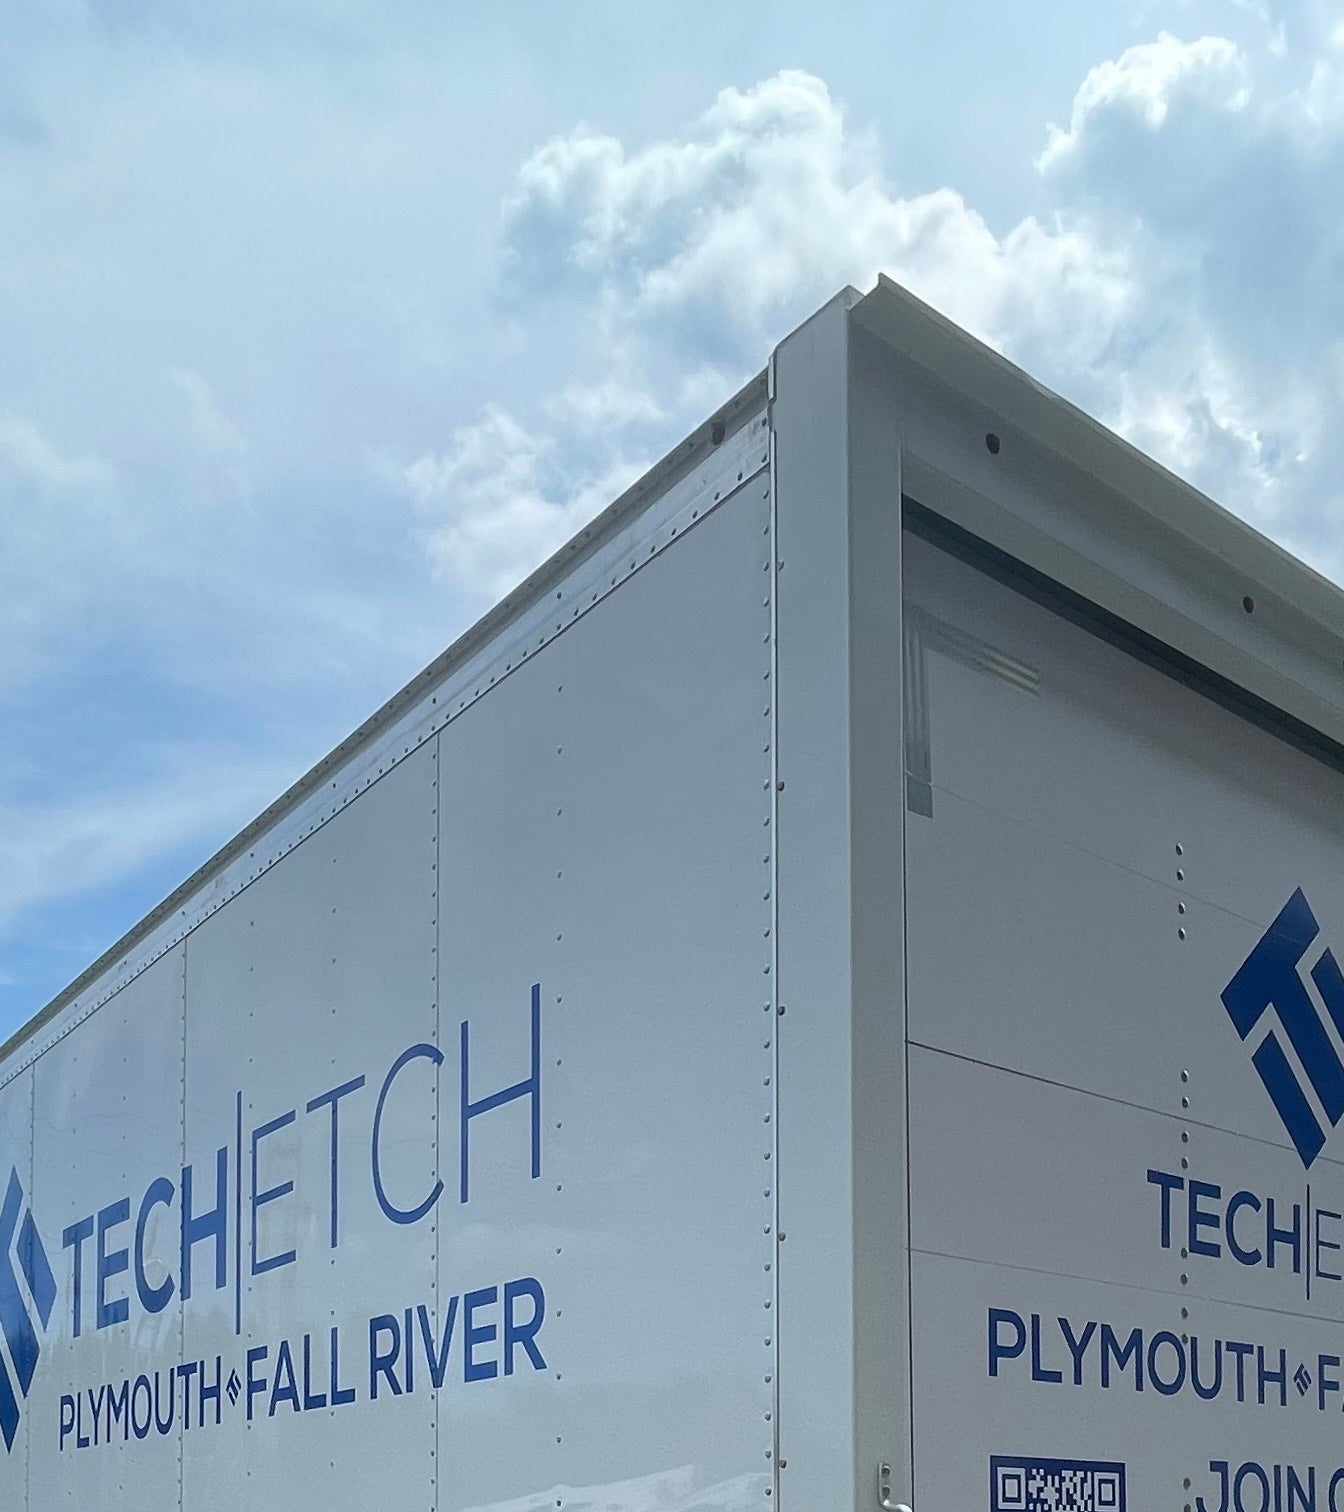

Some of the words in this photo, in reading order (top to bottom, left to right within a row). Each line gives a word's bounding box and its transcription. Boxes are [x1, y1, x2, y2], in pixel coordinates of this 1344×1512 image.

[59, 1354, 222, 1451] PLYMOUTH
[246, 1327, 357, 1421] FALL
[368, 1276, 548, 1401] RIVER
[987, 1307, 1288, 1407] PLYMOUTH
